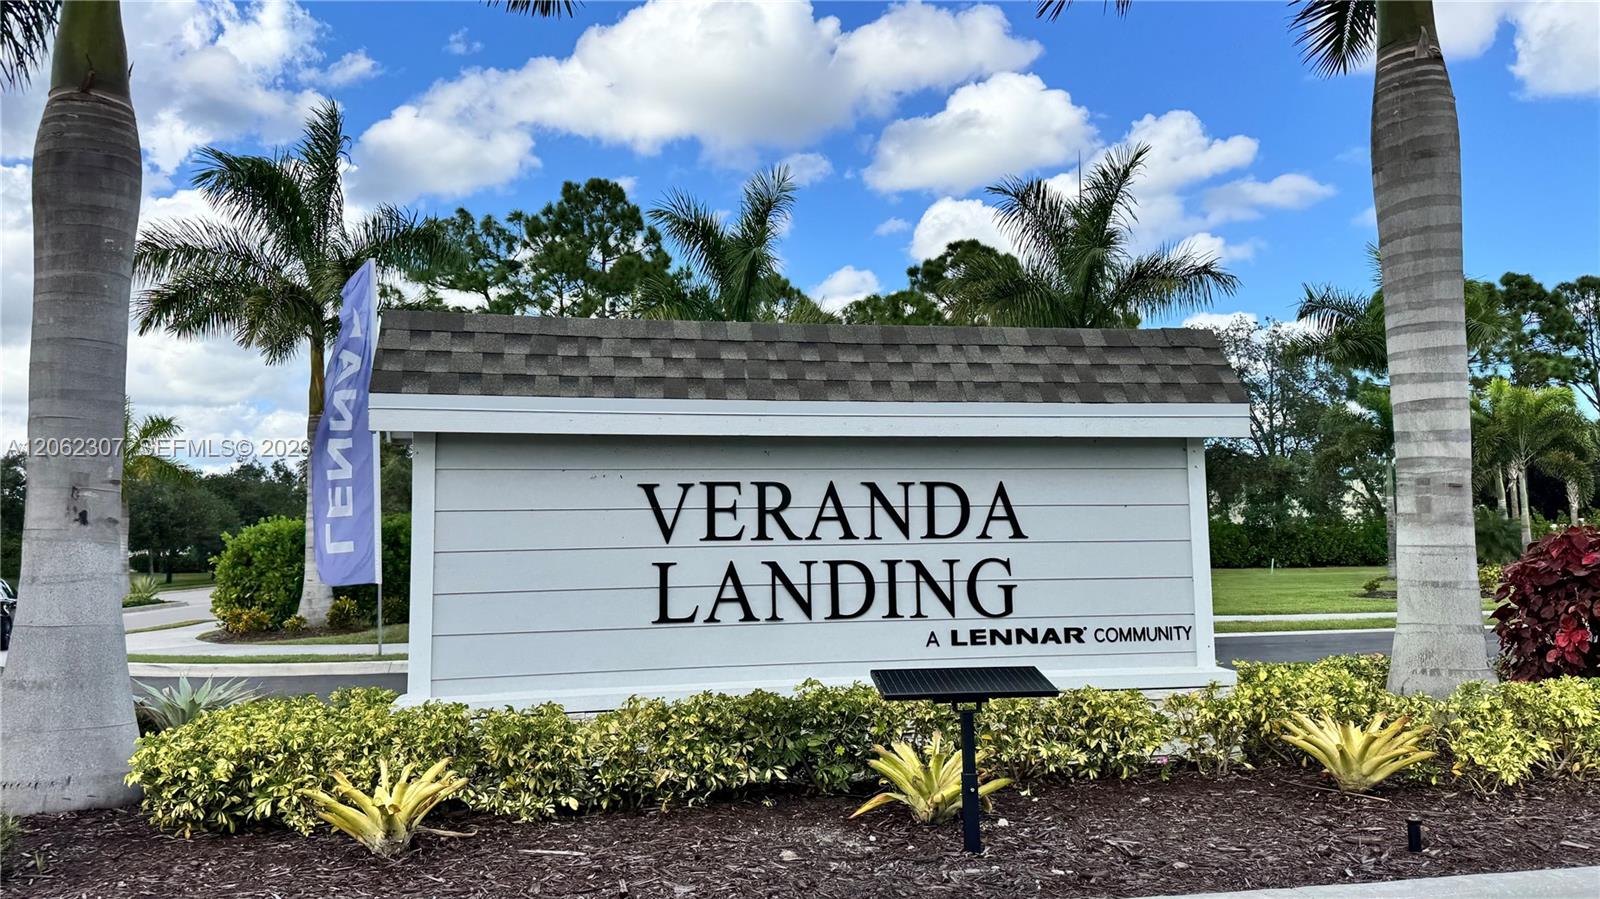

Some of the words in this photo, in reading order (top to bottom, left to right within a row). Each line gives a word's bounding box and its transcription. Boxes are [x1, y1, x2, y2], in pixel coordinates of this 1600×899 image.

[637, 480, 1029, 545] VERANDA
[651, 557, 1018, 624] LANDING
[926, 631, 941, 648] A
[950, 627, 1088, 647] LENNAR
[1094, 626, 1192, 643] COMMUNITY
